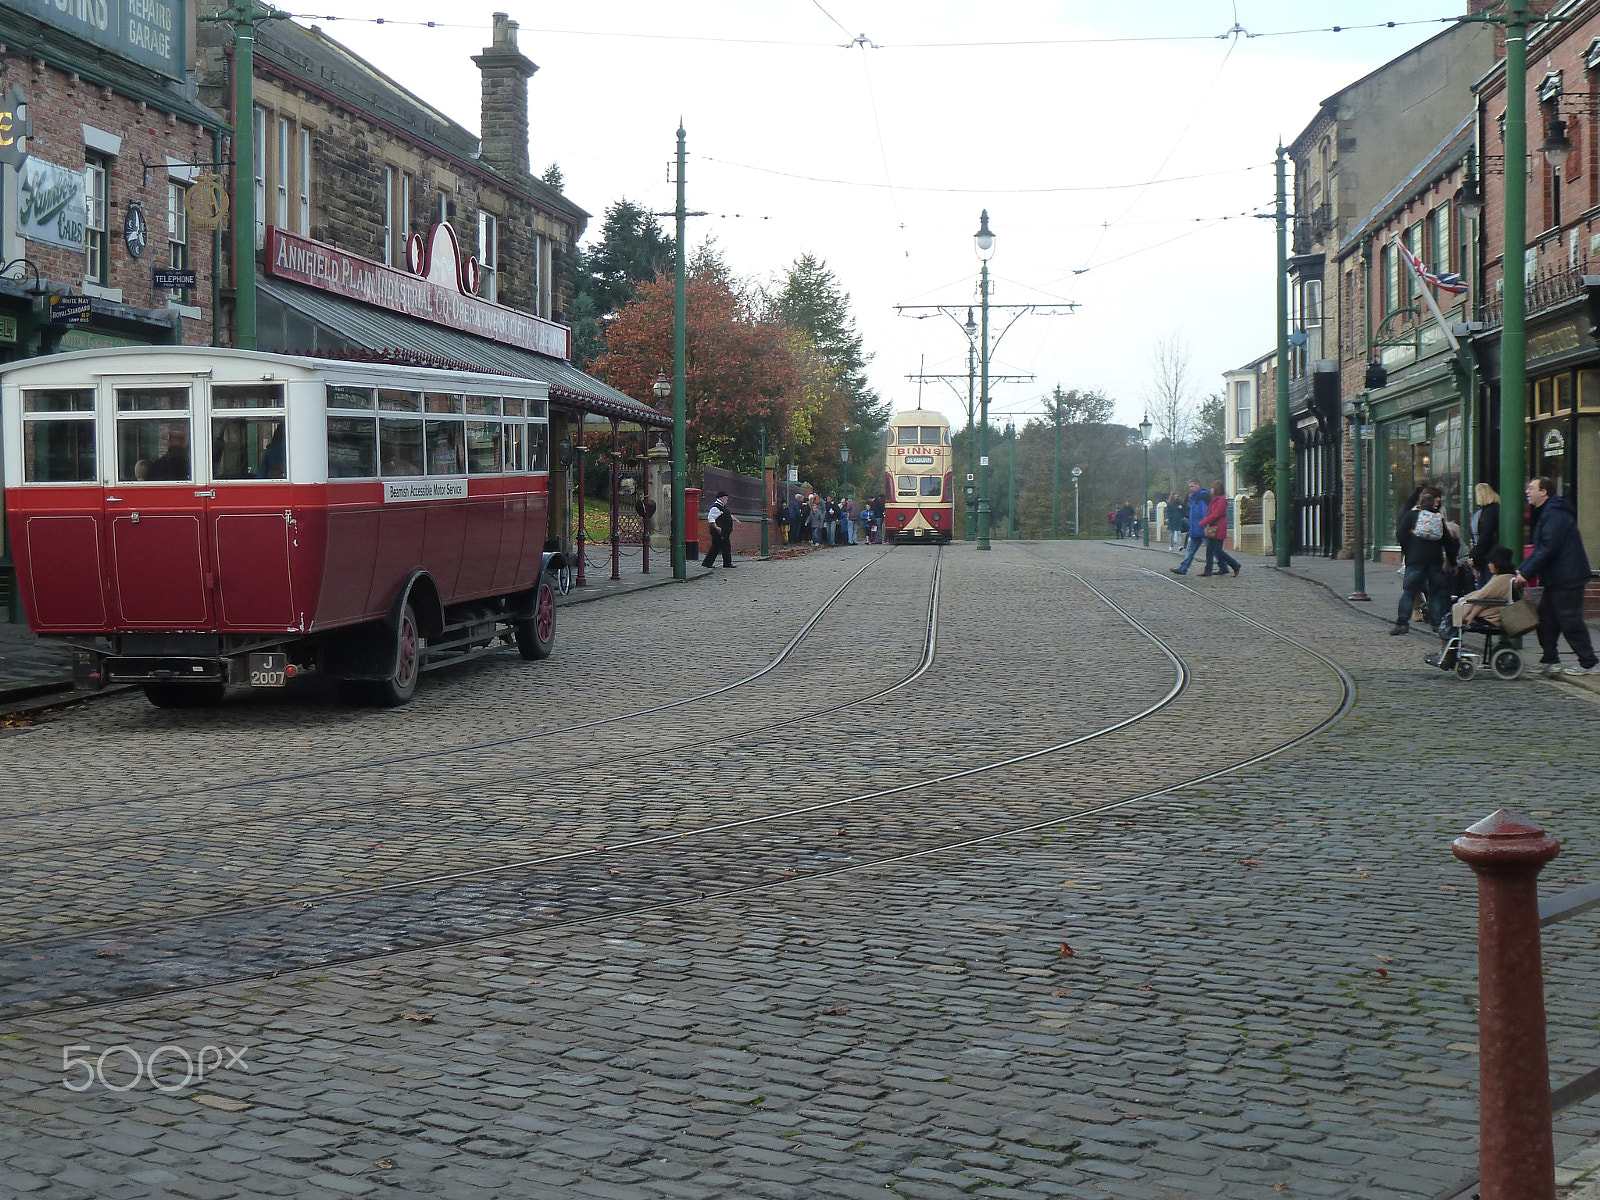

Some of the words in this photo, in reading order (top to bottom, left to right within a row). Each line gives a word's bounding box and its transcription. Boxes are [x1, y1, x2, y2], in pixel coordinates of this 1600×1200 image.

[129, 0, 172, 32] REPAIRS
[129, 19, 171, 60] GARAGE
[275, 236, 340, 284] ANNFIELD
[341, 257, 376, 296] PLAIN
[155, 275, 195, 284] TELEPHONE
[61, 297, 77, 305] WHITE
[52, 310, 68, 320] ROYAL
[67, 304, 91, 317] STANDARD
[897, 447, 942, 455] BINNS
[390, 485, 409, 498] Beamish
[410, 484, 433, 497] Accessible
[433, 483, 446, 496] Motor
[446, 482, 462, 495] Service
[263, 656, 272, 669] J
[251, 671, 285, 684] 2007
